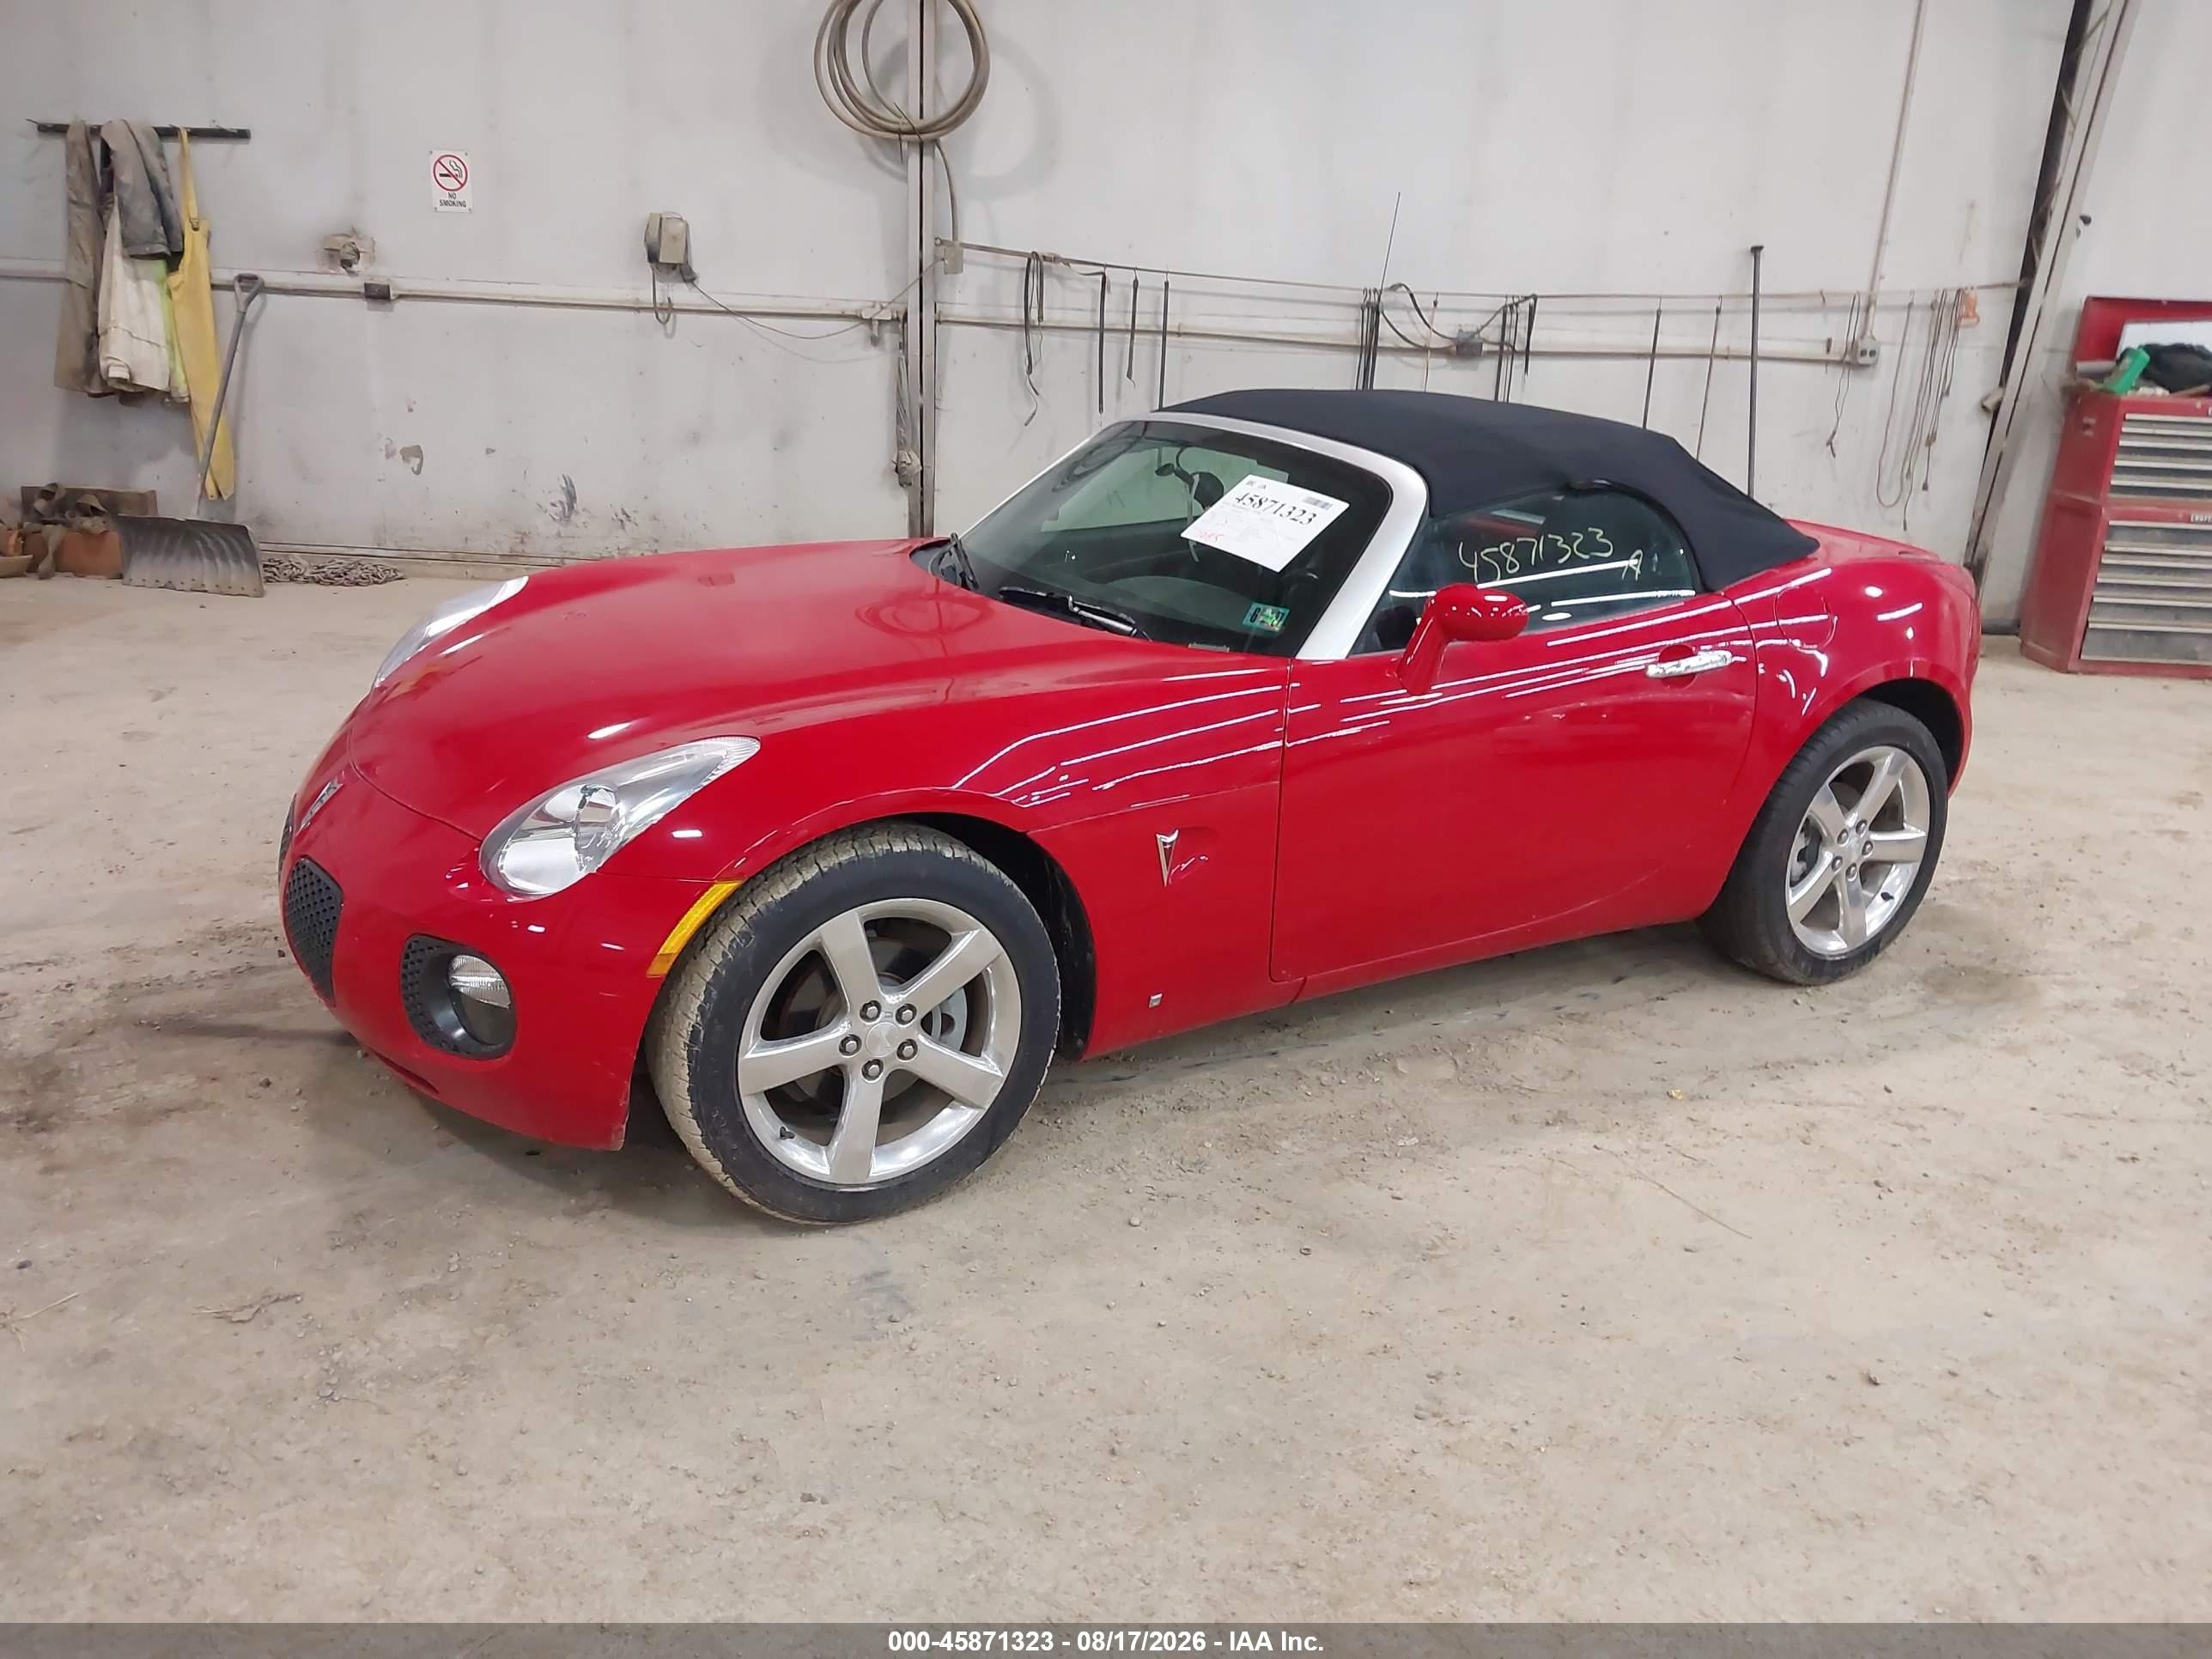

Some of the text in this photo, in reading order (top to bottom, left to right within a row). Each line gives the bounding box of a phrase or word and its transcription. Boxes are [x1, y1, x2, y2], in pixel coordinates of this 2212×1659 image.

[439, 199, 467, 208] SMOKING
[1235, 492, 1317, 526] 45871323
[1458, 527, 1613, 583] 45871323
